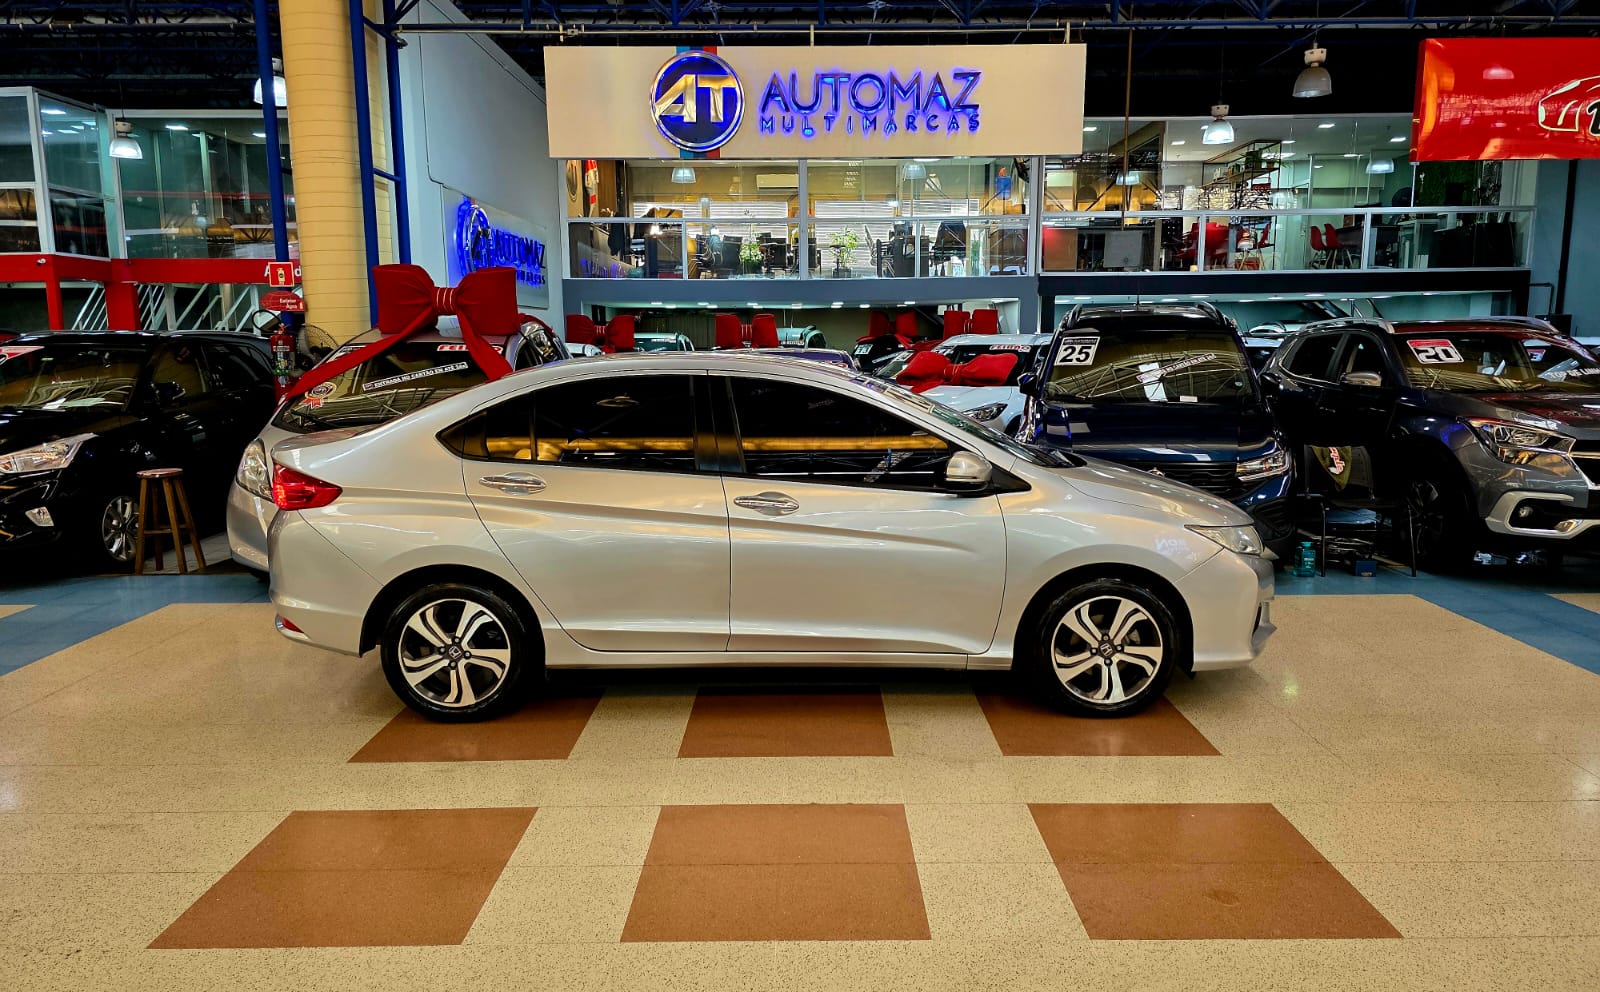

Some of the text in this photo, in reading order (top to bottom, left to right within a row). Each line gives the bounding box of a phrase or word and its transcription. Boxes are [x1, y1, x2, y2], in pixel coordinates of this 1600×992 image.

[655, 74, 737, 122] AT
[760, 71, 982, 114] AUTOMAZ
[760, 114, 981, 135] MULTIMARCAS
[1059, 346, 1092, 362] 25
[1416, 346, 1460, 361] 20
